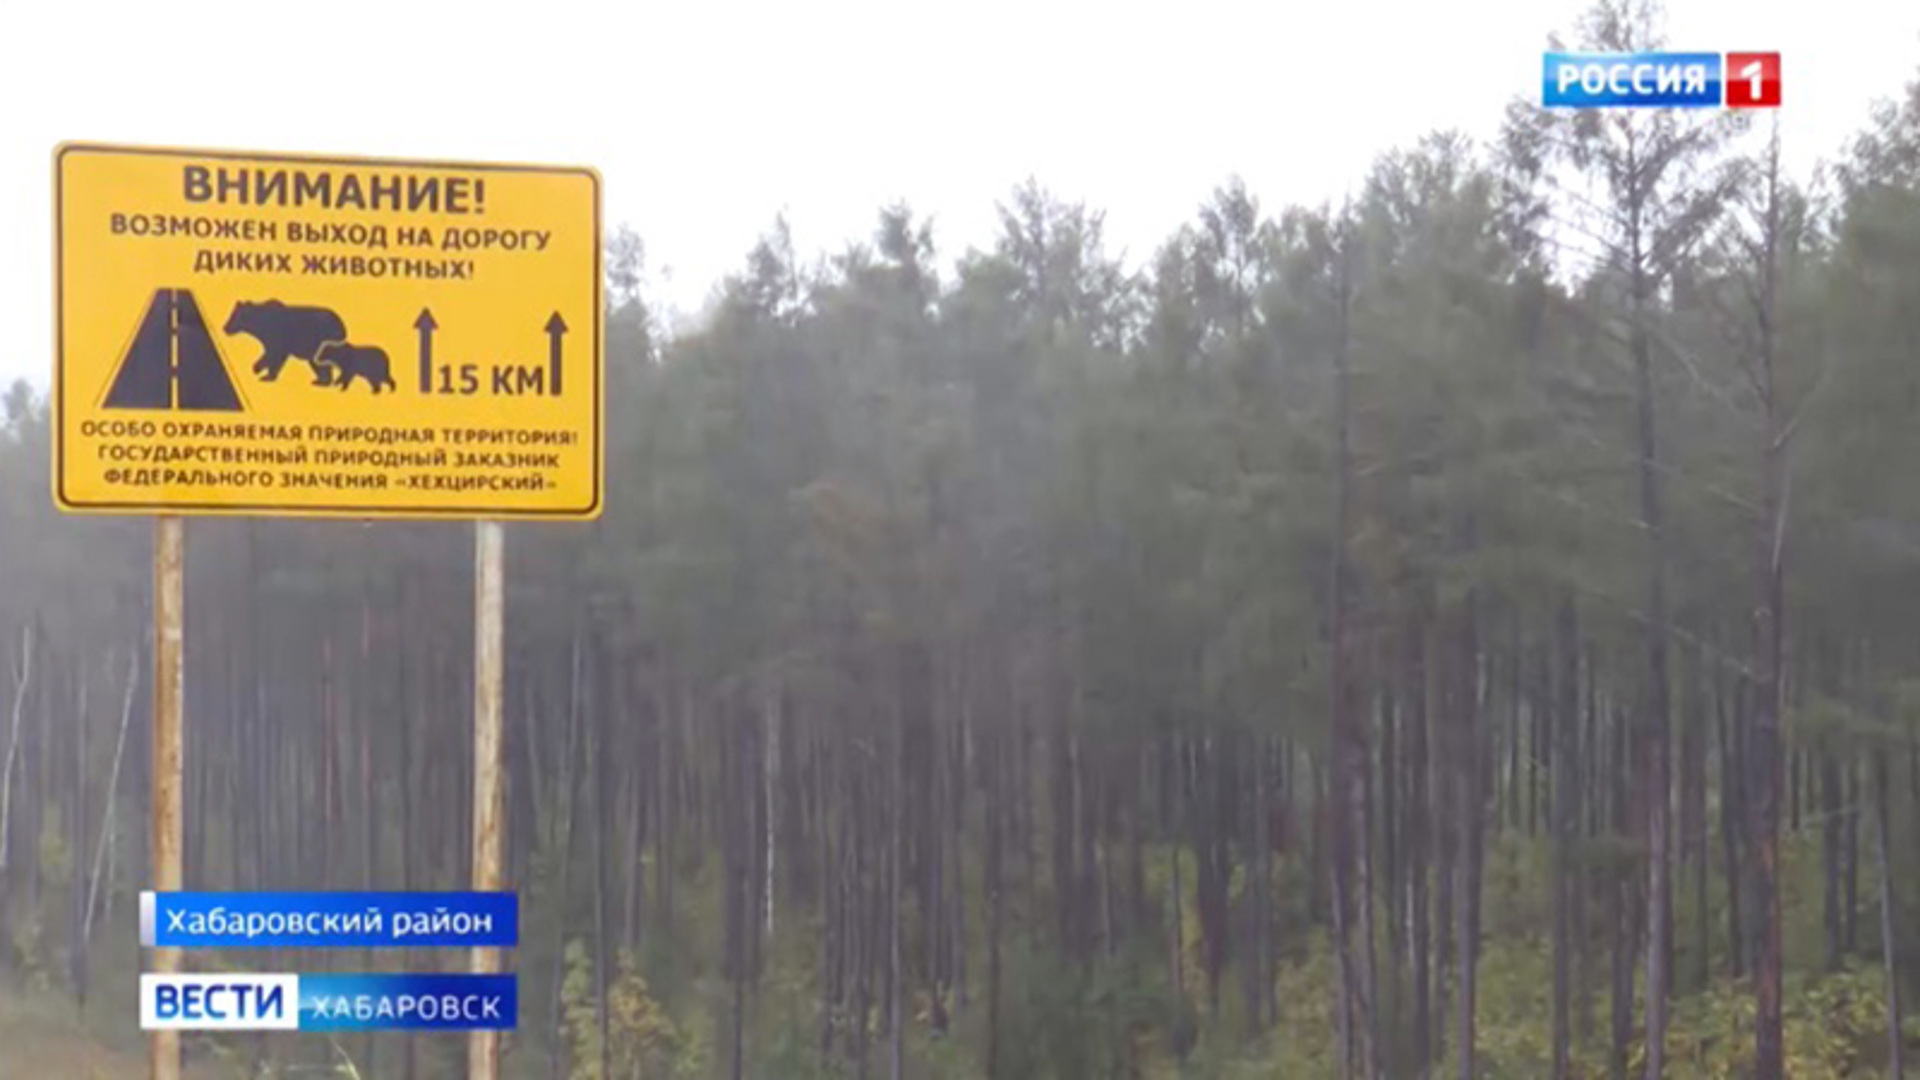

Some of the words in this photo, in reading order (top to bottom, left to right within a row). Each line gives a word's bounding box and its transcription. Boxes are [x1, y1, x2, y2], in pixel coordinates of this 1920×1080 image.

[183, 165, 485, 214] ВНИМАНИЕ!
[110, 212, 277, 241] ВОЗМОЖЕН
[287, 221, 388, 249] ВЫХОД
[396, 226, 434, 247] НА
[441, 227, 551, 251] ДОРОГУ
[193, 249, 292, 274] ДИКИХ
[301, 254, 474, 280] ЖИВОТНЫХ!
[438, 363, 479, 396] 15
[491, 364, 544, 396] КМ
[80, 420, 156, 438] ОСОБО
[162, 421, 302, 441] ОХРАНЯЕМАЯ
[308, 425, 435, 445] ПРИРОДНАЯ
[441, 428, 578, 446] ТЕРРИТОРИЯ!
[98, 444, 308, 465] ГОСУДАРСТВЕННЫЙ
[314, 448, 447, 469] ПРИРОДНЫЙ
[453, 452, 560, 469] ЗАКАЗНИК
[103, 468, 274, 486] ФЕДЕРАЛЬНОГО
[280, 471, 388, 490] ЗНАЧЕНИЯ
